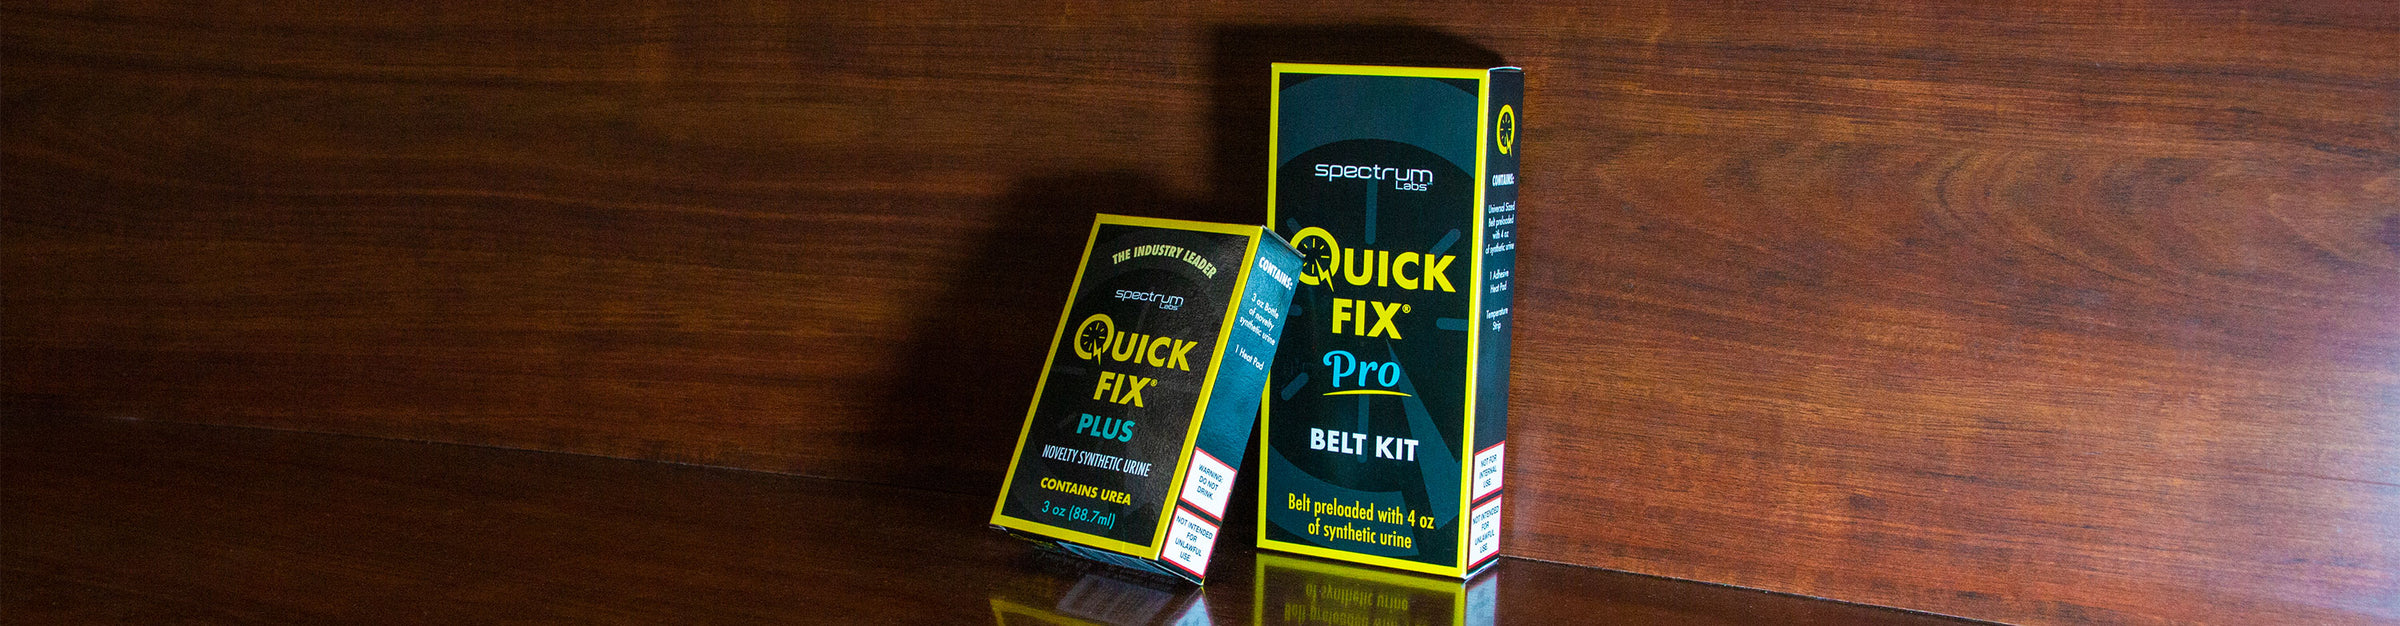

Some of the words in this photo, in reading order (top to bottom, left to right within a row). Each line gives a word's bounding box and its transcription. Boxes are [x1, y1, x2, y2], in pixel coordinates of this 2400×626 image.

[1315, 164, 1433, 182] spectrum
[1112, 249, 1131, 264] THE
[1134, 245, 1184, 258] INDUSTRY
[1183, 250, 1217, 279] LEADER
[1259, 256, 1293, 290] CONTAINS:
[1290, 226, 1456, 292] QUICK
[1115, 289, 1184, 307] spectrum
[1251, 293, 1257, 302] 3
[1257, 298, 1264, 308] oz
[1264, 302, 1279, 319] Bottle
[1240, 316, 1262, 336] synthetic
[1262, 333, 1275, 346] urine
[1249, 308, 1257, 316] of
[1255, 312, 1275, 332] novelty
[1074, 314, 1198, 371] QUICK
[1235, 344, 1239, 353] 1
[1239, 348, 1253, 363] Heat
[1253, 357, 1264, 370] Pad
[1323, 350, 1400, 387] Pro
[1076, 413, 1135, 442] PLUS
[1310, 428, 1367, 455] BELT
[1375, 436, 1419, 461] KIT
[1042, 444, 1079, 463] NOVELTY
[1078, 451, 1124, 473] SYNTHETIC
[1123, 459, 1152, 477] URINE
[1199, 464, 1223, 482] WARNING:
[1040, 477, 1098, 498] CONTAINS
[1101, 488, 1132, 505] UREA
[1198, 476, 1207, 485] DO
[1207, 480, 1218, 490] NOT
[1042, 500, 1050, 513] 3
[1052, 505, 1065, 516] oz
[1068, 508, 1116, 530] (88.7ml)
[1288, 493, 1311, 512] Belt
[1314, 498, 1374, 521] preloaded
[1377, 506, 1404, 525] with
[1407, 510, 1416, 527] 4
[1419, 515, 1435, 530] oz
[1176, 516, 1188, 527] NOT
[1188, 521, 1214, 540] INTENDED
[1186, 532, 1197, 542] FOR
[1308, 518, 1320, 535] of
[1323, 521, 1376, 544] synthetic
[1380, 531, 1412, 549] urine
[1175, 538, 1202, 557] UNLAWFUL
